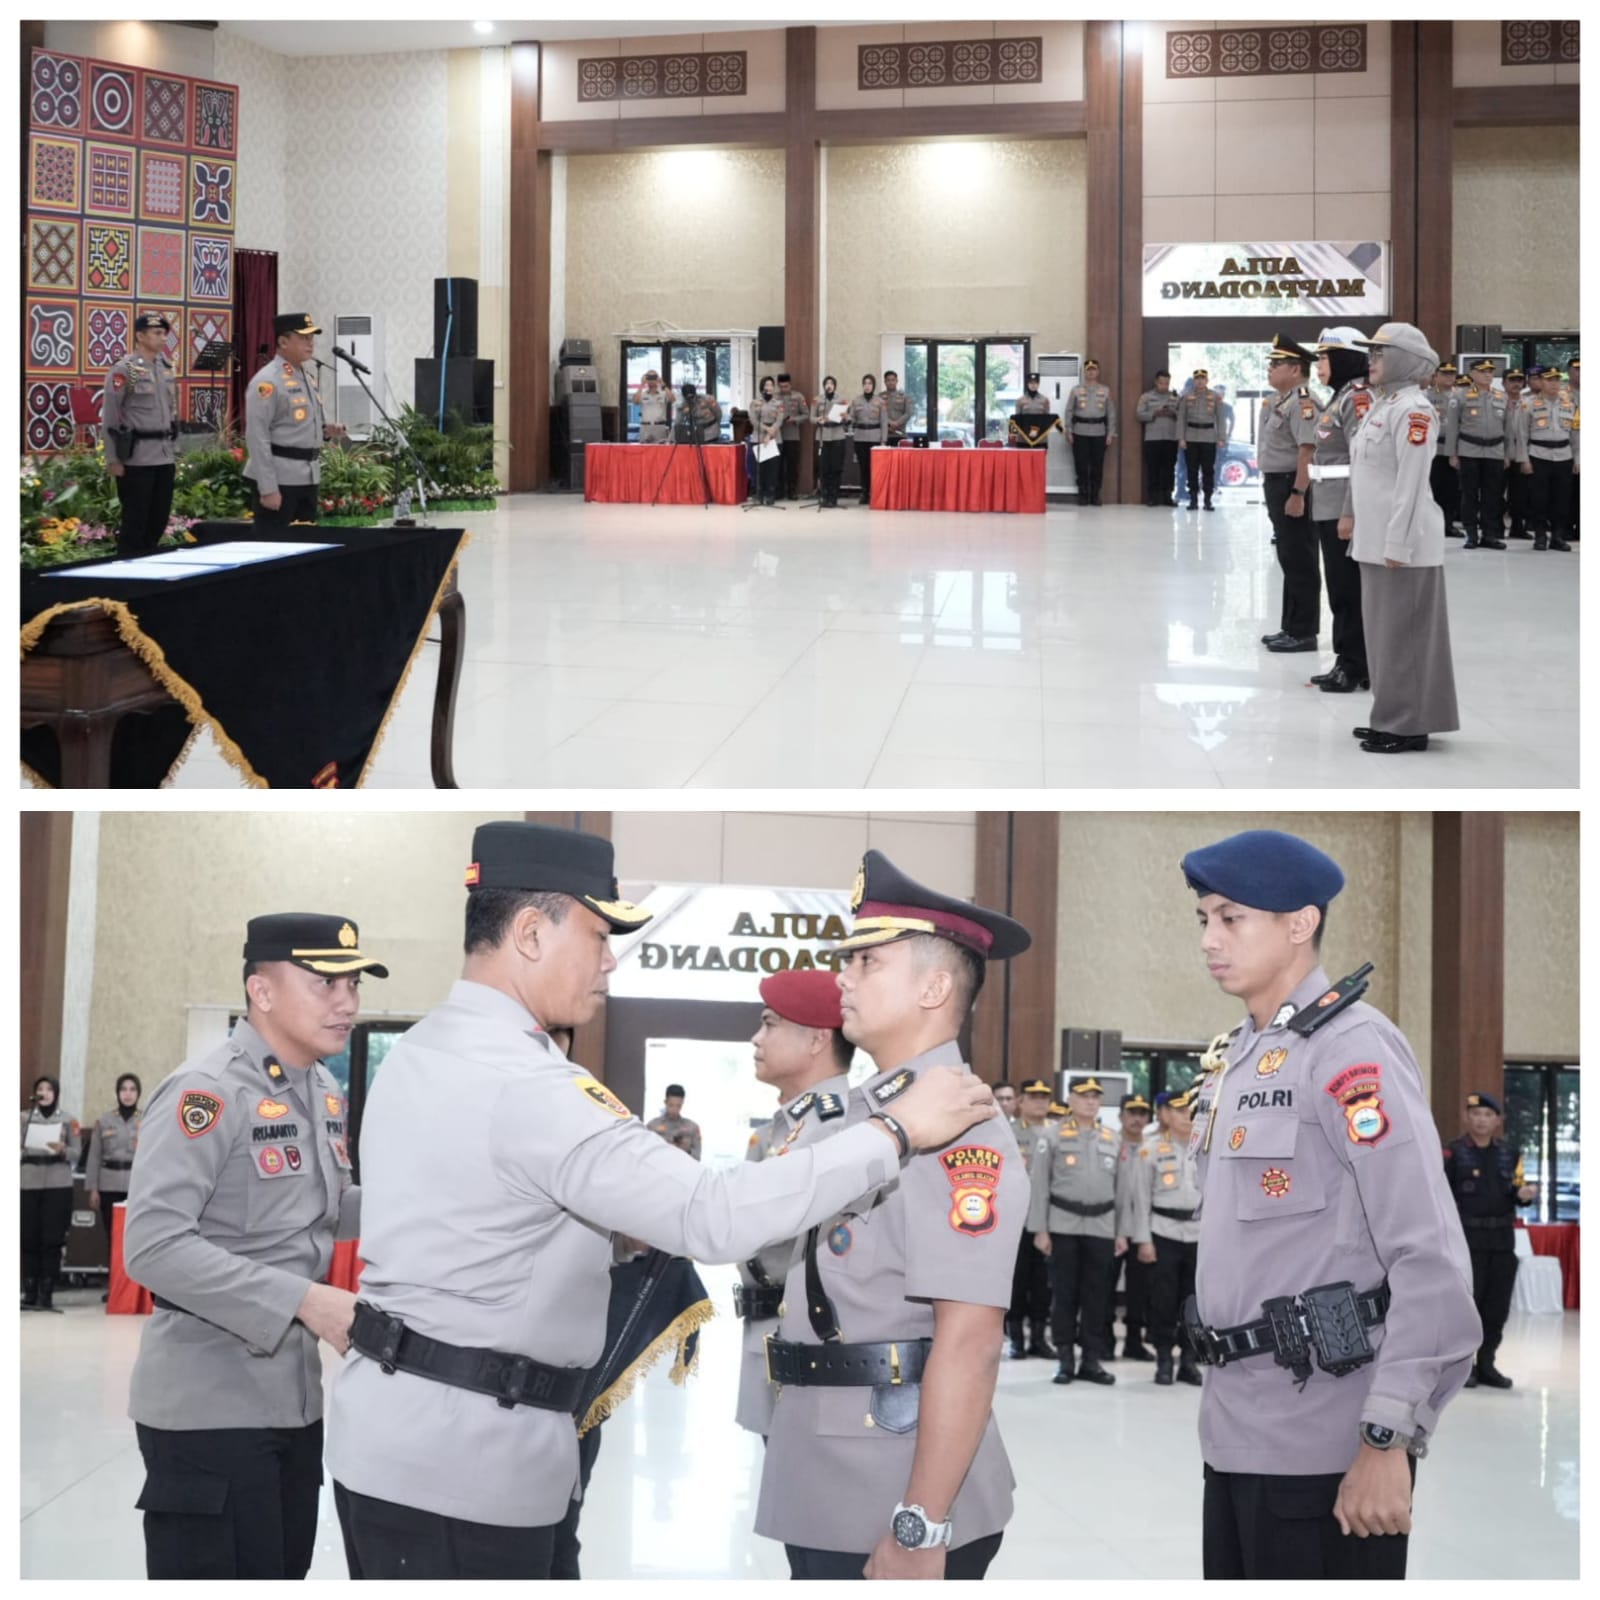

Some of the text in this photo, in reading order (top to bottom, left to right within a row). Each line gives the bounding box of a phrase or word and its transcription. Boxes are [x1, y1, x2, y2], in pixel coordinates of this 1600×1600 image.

[1237, 1089, 1293, 1111] POLRI
[946, 1149, 999, 1164] POLRES
[476, 1356, 558, 1400] PORI
